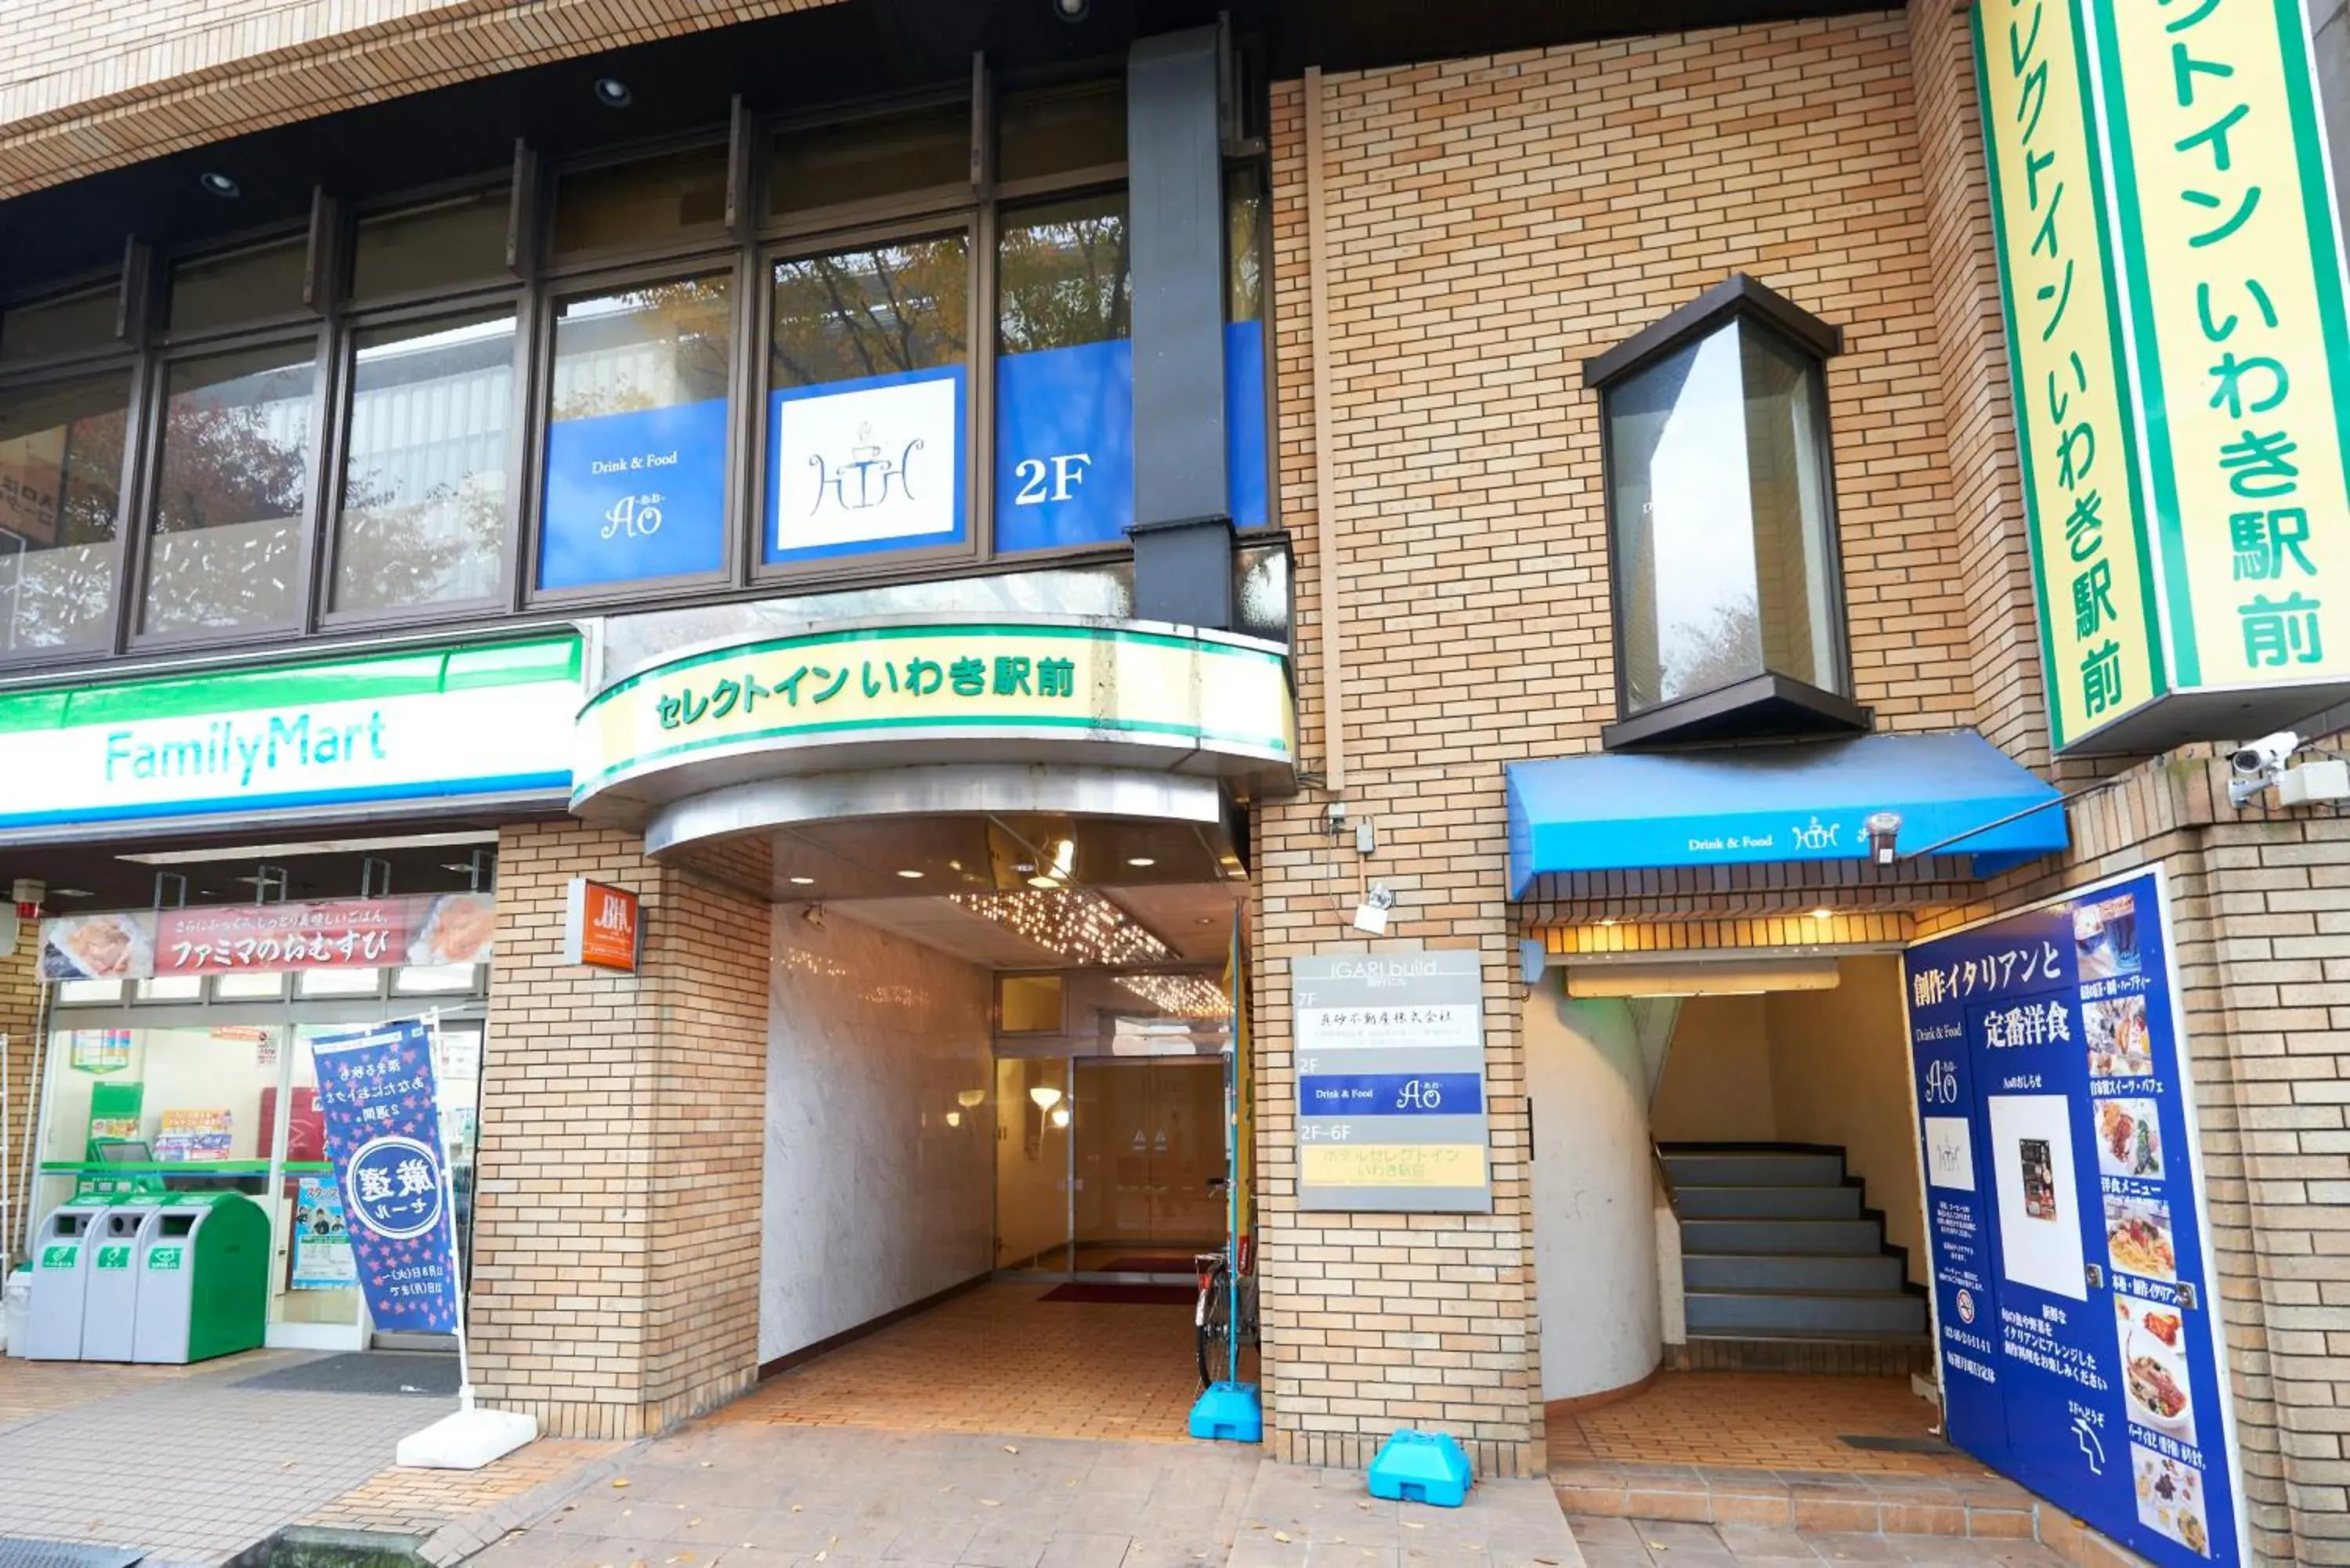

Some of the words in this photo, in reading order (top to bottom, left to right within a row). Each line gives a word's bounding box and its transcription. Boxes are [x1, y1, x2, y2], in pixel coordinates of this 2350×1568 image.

[2009, 0, 2123, 719] レクトインいわき駅前
[591, 457, 627, 475] Drink
[631, 457, 643, 469] &
[647, 451, 678, 468] Food
[1014, 453, 1092, 505] 2F
[106, 710, 388, 786] FamilyMart
[1688, 838, 1723, 851] Drink
[1726, 838, 1740, 848] &
[1742, 834, 1773, 848] Food
[171, 929, 389, 968] ファミマのおむすび
[1330, 960, 1384, 980] IGARI
[1914, 940, 2062, 1007] 創作イタリアンと
[1297, 992, 1318, 1006] 7F
[1984, 999, 2071, 1050] 定番洋食
[1300, 1058, 1320, 1074] 2F
[1315, 1089, 1340, 1099] Drink
[1351, 1089, 1373, 1099] Food
[1300, 1124, 1352, 1140] 2F-6F
[2100, 1176, 2162, 1196] 洋食メニュー
[2003, 1324, 2098, 1371] イタリアンにアレンジした
